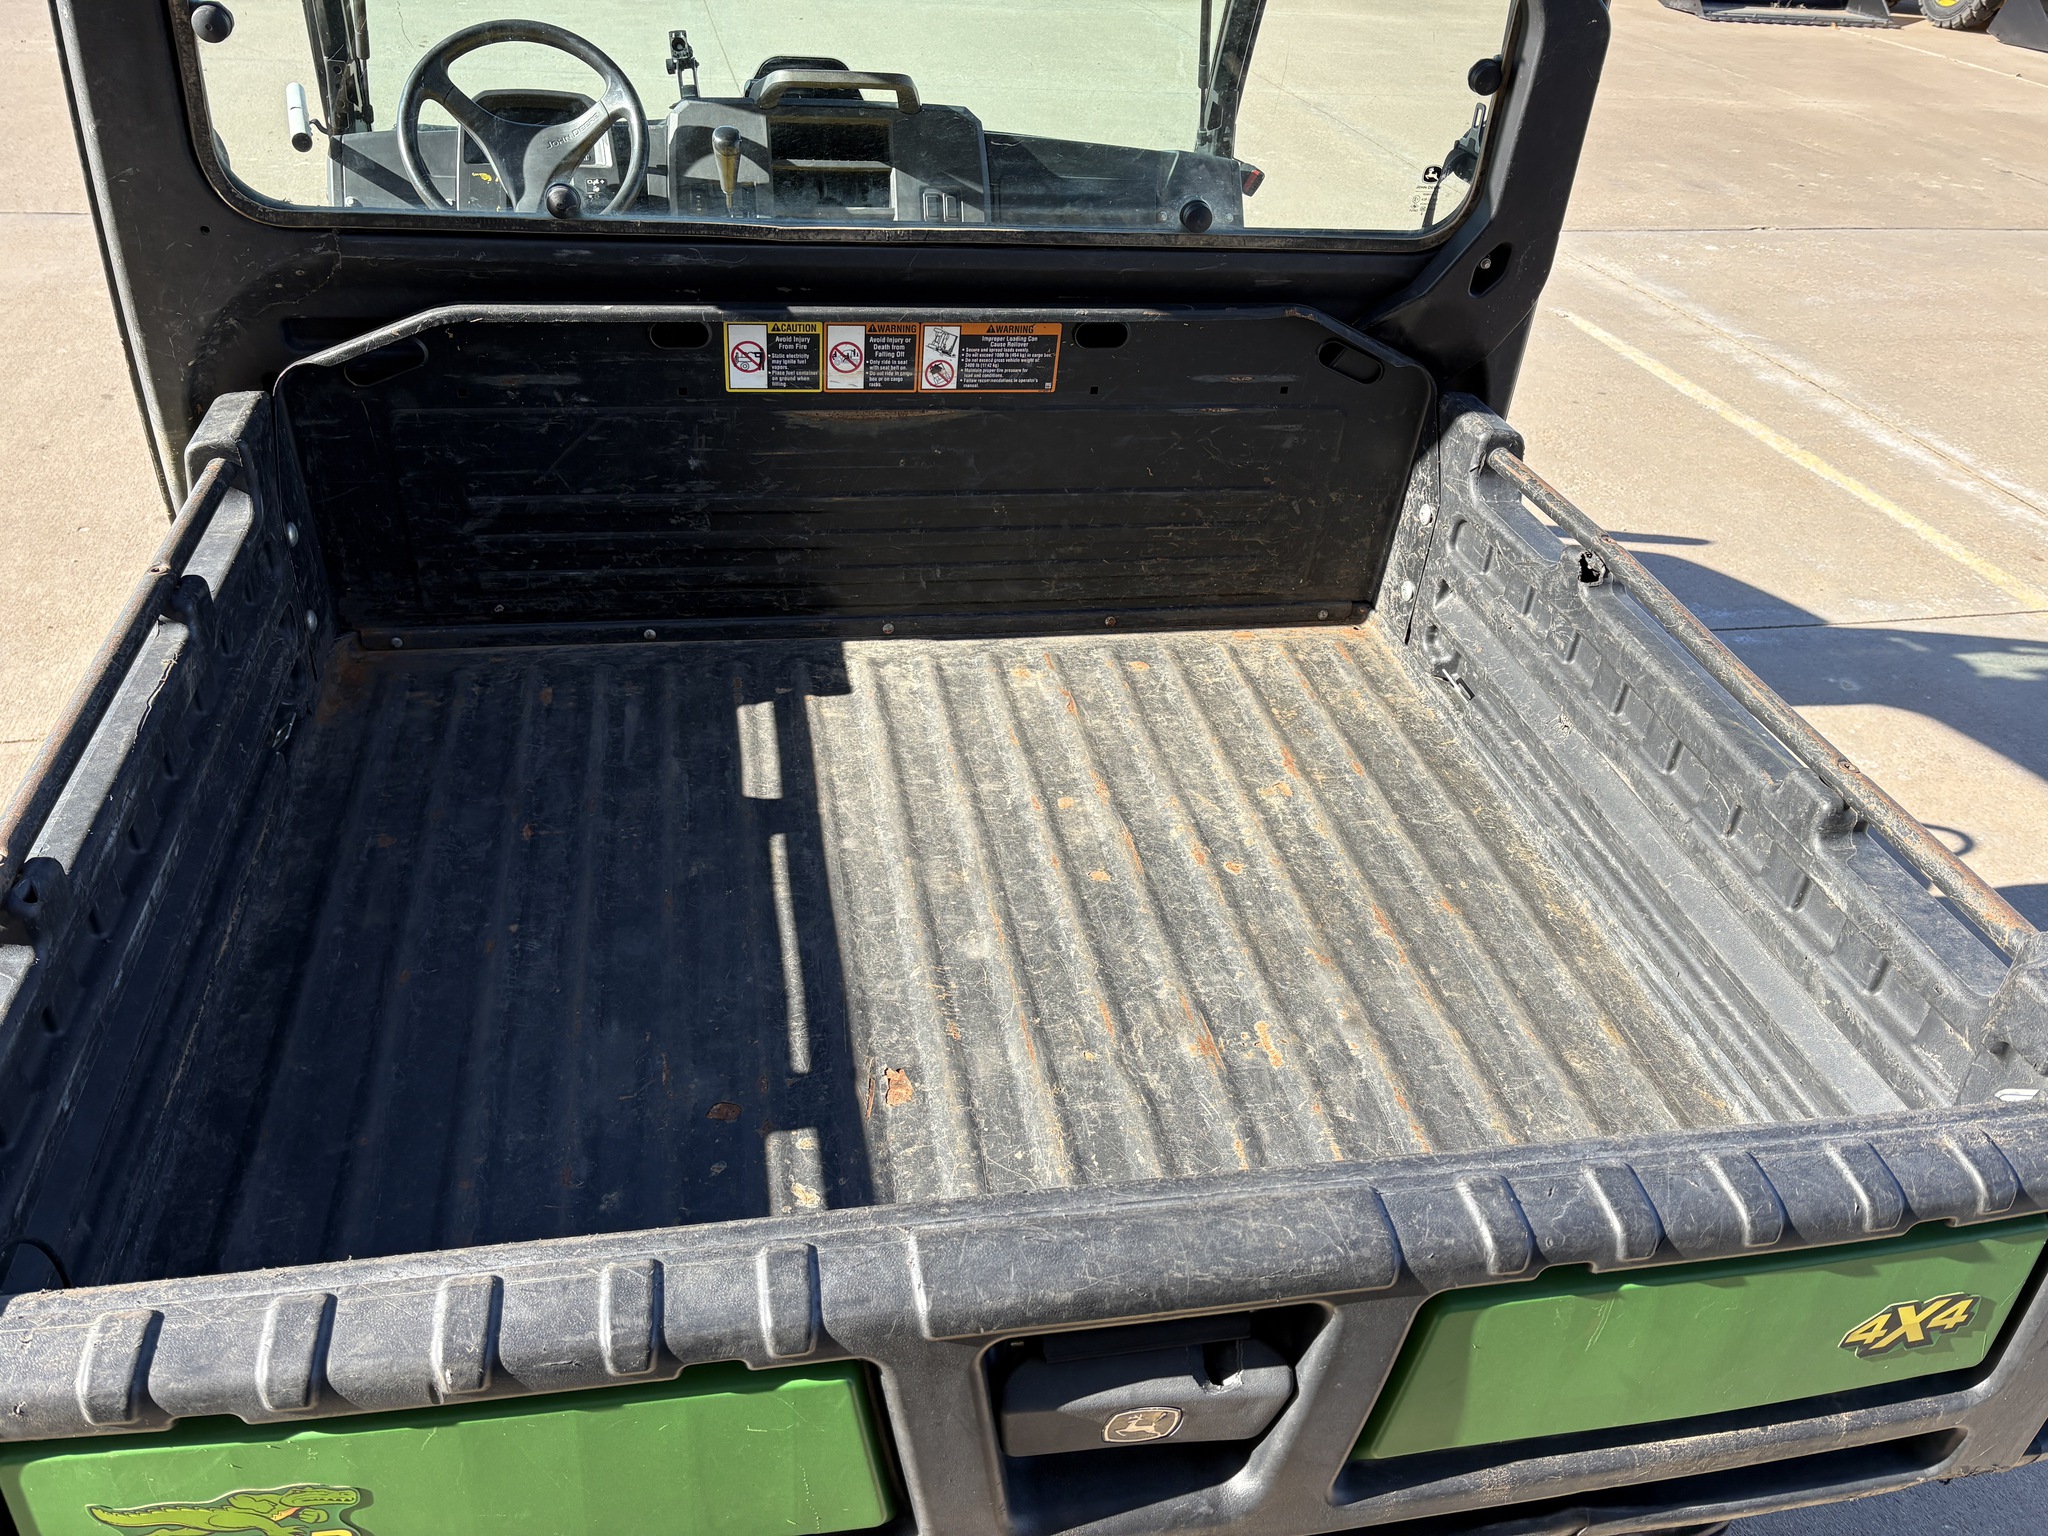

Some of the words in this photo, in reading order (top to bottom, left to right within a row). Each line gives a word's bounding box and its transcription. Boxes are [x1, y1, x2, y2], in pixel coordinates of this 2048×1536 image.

[547, 134, 572, 150] JOHN
[571, 112, 599, 138] DEERE
[781, 324, 816, 332] CAUTION
[996, 325, 1033, 333] WARNING
[1845, 1298, 1973, 1350] 4X4
